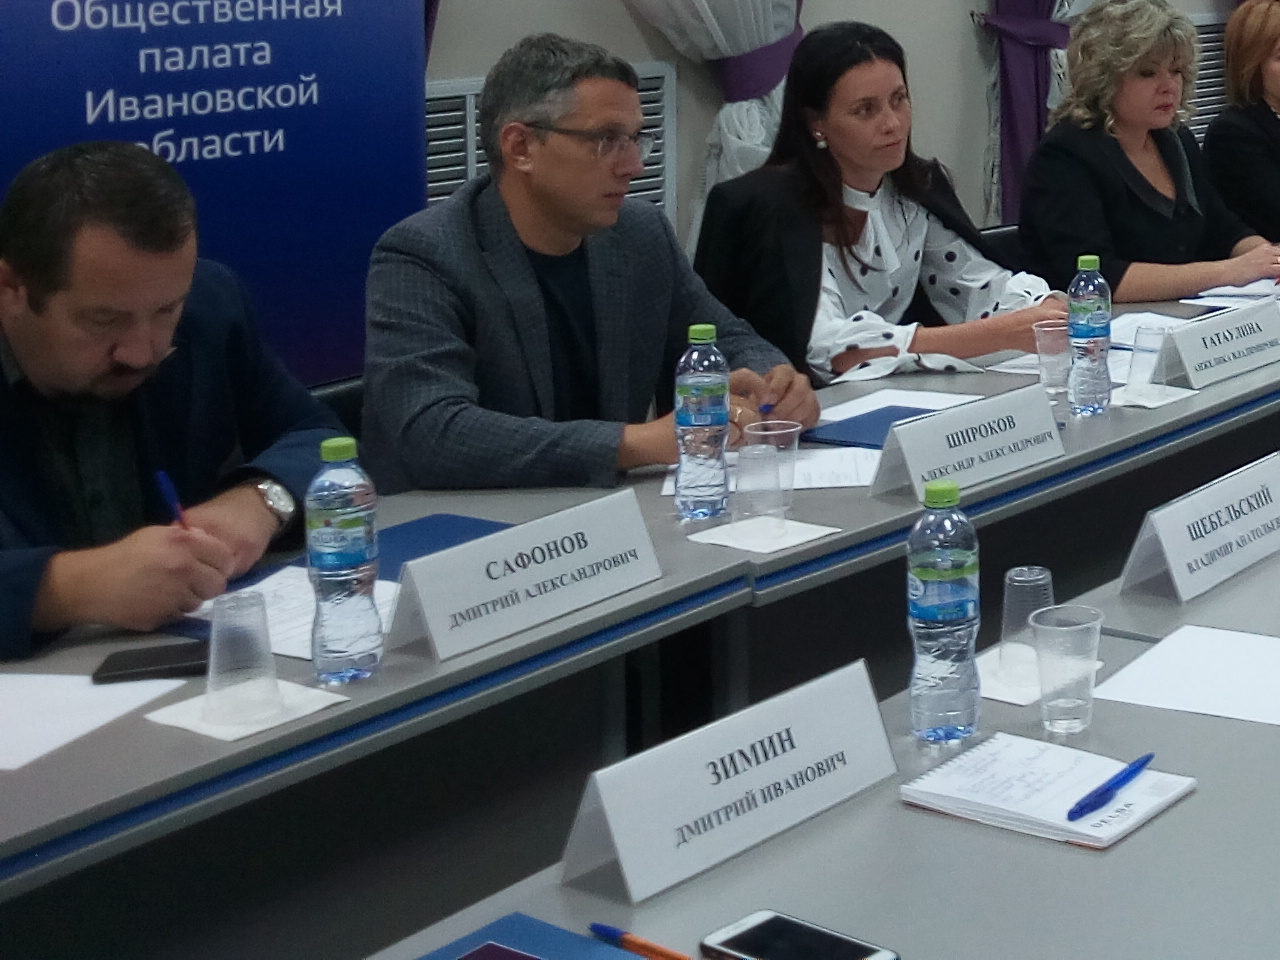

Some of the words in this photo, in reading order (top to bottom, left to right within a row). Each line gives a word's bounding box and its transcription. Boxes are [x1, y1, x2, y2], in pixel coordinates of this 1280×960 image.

[138, 41, 272, 74] палата
[85, 73, 320, 125] Ивановской
[945, 414, 1017, 449] ШИРОКОВ
[921, 456, 976, 482] АЛЕКСАНДР
[1186, 483, 1274, 541] ЩЕБЕЛЬСКИЙ
[485, 530, 589, 580] САФОНОВ
[449, 589, 521, 631] ДМИТРИЙ
[524, 548, 639, 599] АЛЕКСАНДРОВИЧ
[705, 727, 797, 786] ЗИМИН
[674, 790, 759, 849] ДМИТРИЙ
[760, 750, 848, 805] ИВАНОВИЧ
